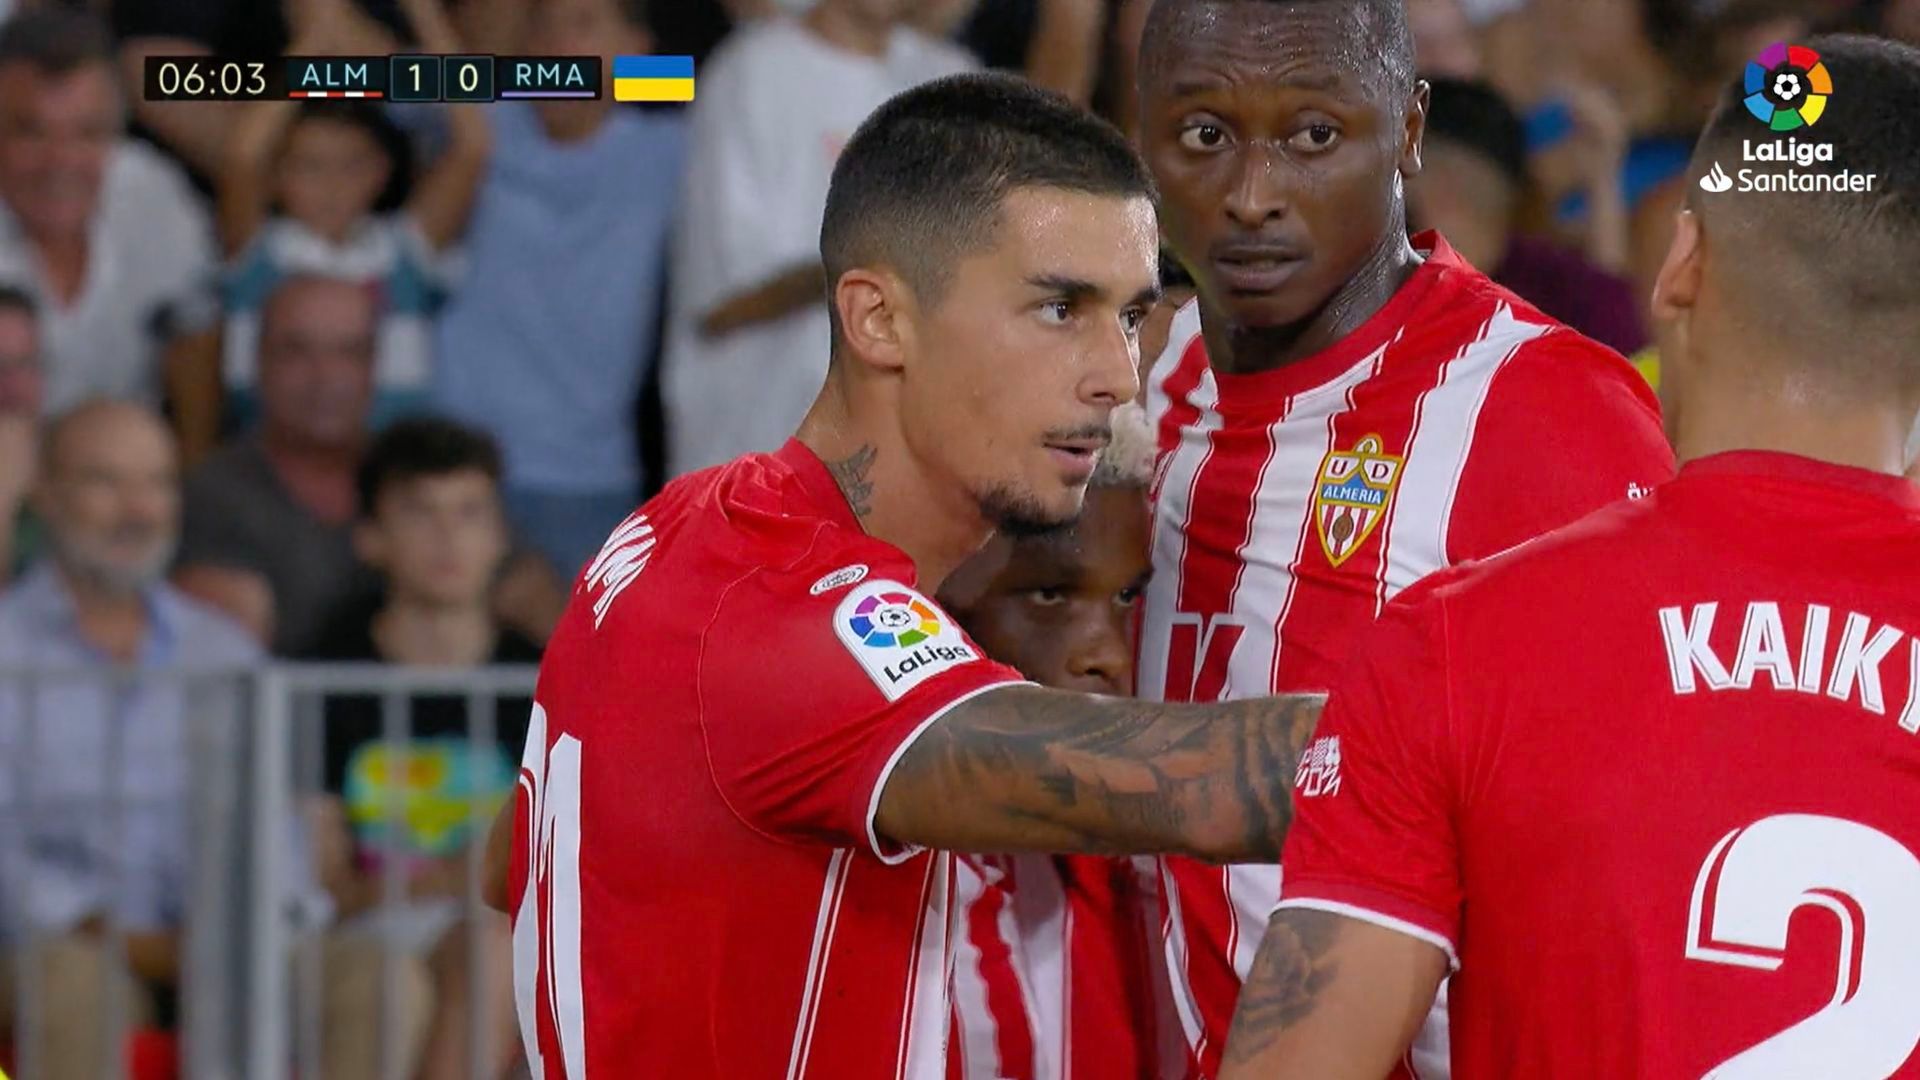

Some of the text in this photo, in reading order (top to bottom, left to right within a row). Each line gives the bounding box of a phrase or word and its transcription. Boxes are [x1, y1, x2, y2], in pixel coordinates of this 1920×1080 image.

[1331, 459, 1389, 479] U D
[1322, 485, 1381, 505] ALMERIA
[884, 645, 971, 684] LaLiga
